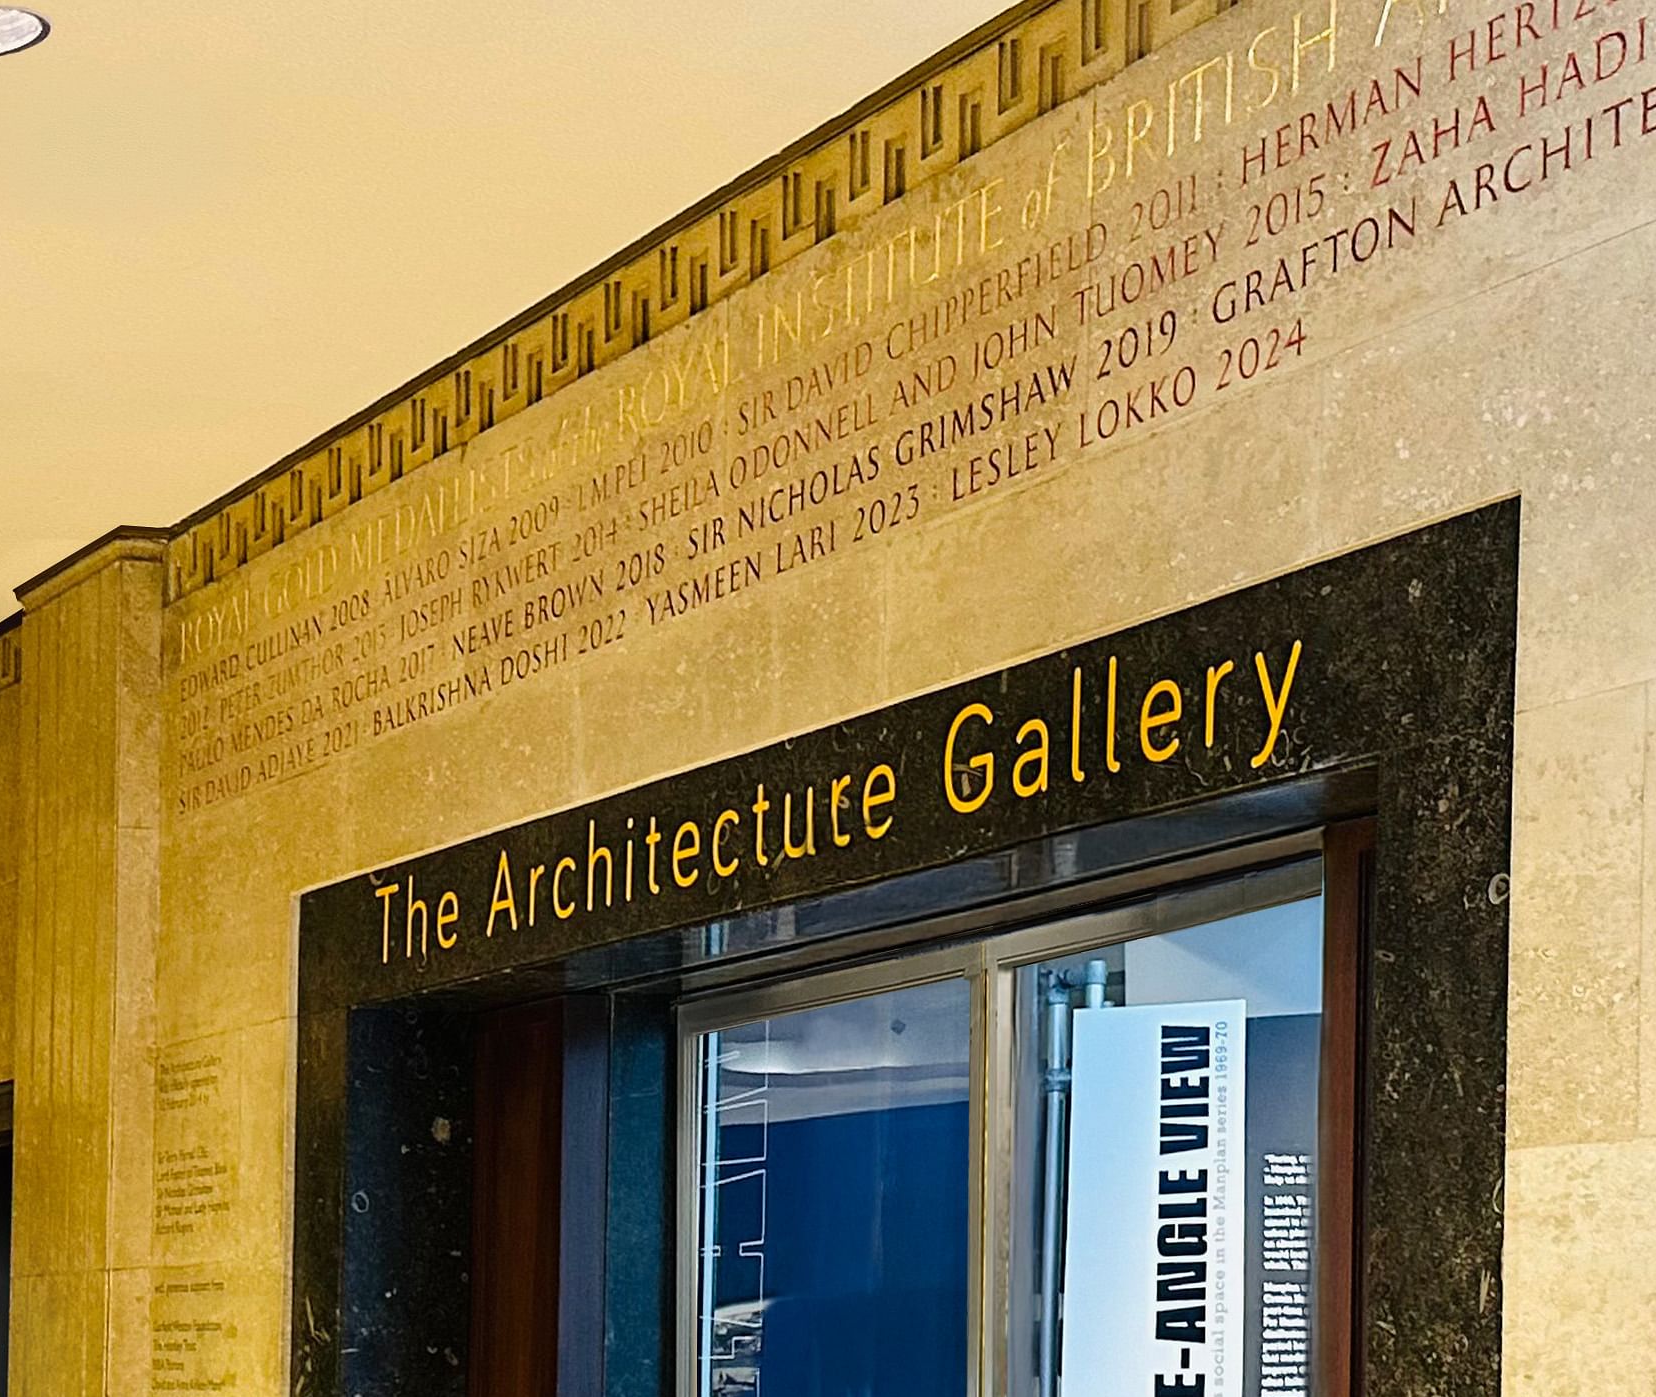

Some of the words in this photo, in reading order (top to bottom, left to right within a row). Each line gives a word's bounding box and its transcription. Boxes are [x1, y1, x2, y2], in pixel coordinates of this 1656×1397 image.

[757, 178, 1006, 369] INSTITUTE
[1085, 0, 1337, 199] BRITISH
[181, 654, 239, 702] EDWARD
[245, 615, 323, 671] CULLINAN
[329, 589, 370, 632] 2008
[459, 527, 501, 569] SIZA
[509, 495, 560, 545] 2009
[659, 421, 713, 474] 2010
[737, 388, 776, 436] SIR
[786, 341, 874, 413] DAVID
[886, 223, 1108, 361] CHIPPERFIELD
[1129, 175, 1197, 242] 2011
[1241, 56, 1423, 190] HERMAN
[219, 682, 261, 723] PETER
[266, 642, 345, 700] ZUMTHOR
[398, 587, 463, 643] JOSEPH
[471, 542, 560, 606] RYKWERT
[638, 469, 720, 532] SHEILA
[888, 355, 957, 416] AND
[970, 304, 1058, 382] JOHN
[1073, 223, 1226, 327] TUOMEY
[1244, 173, 1327, 250] 2015
[1369, 95, 1497, 190] ZAHA
[232, 706, 294, 753] MENDES
[301, 695, 324, 725] DA
[333, 664, 391, 708] ROCHA
[398, 643, 435, 684] 2017
[452, 609, 514, 660] NEAVE
[524, 568, 605, 630] BROWN
[615, 543, 665, 592] 2018
[687, 516, 726, 560] SIR
[737, 445, 880, 534] NICHOLAS
[895, 354, 1079, 467] GRIMSHAW
[1096, 310, 1178, 381] 2019
[1212, 197, 1418, 324] GRAFTON
[205, 765, 251, 805] DAVID
[373, 666, 491, 737] BALKRISHNA
[500, 632, 568, 686] DOSHI
[577, 609, 627, 655] 2022
[645, 551, 762, 626] YASMEEN
[776, 518, 837, 575] LARI
[852, 482, 920, 544] 2023
[951, 421, 1063, 501] LESLEY
[1078, 365, 1196, 450] LOKKO
[1215, 317, 1308, 392] 2024
[374, 881, 459, 965] The
[484, 755, 896, 939] Architecture
[943, 639, 1304, 815] Gallery
[1159, 1025, 1210, 1156] VIEW
[1214, 1021, 1228, 1080] 1969-70
[1215, 1086, 1227, 1134] series
[1213, 1138, 1229, 1210] Manplan
[1213, 1216, 1225, 1242] the
[1213, 1248, 1225, 1263] in
[1214, 1270, 1228, 1324] space
[1212, 1331, 1224, 1386] social
